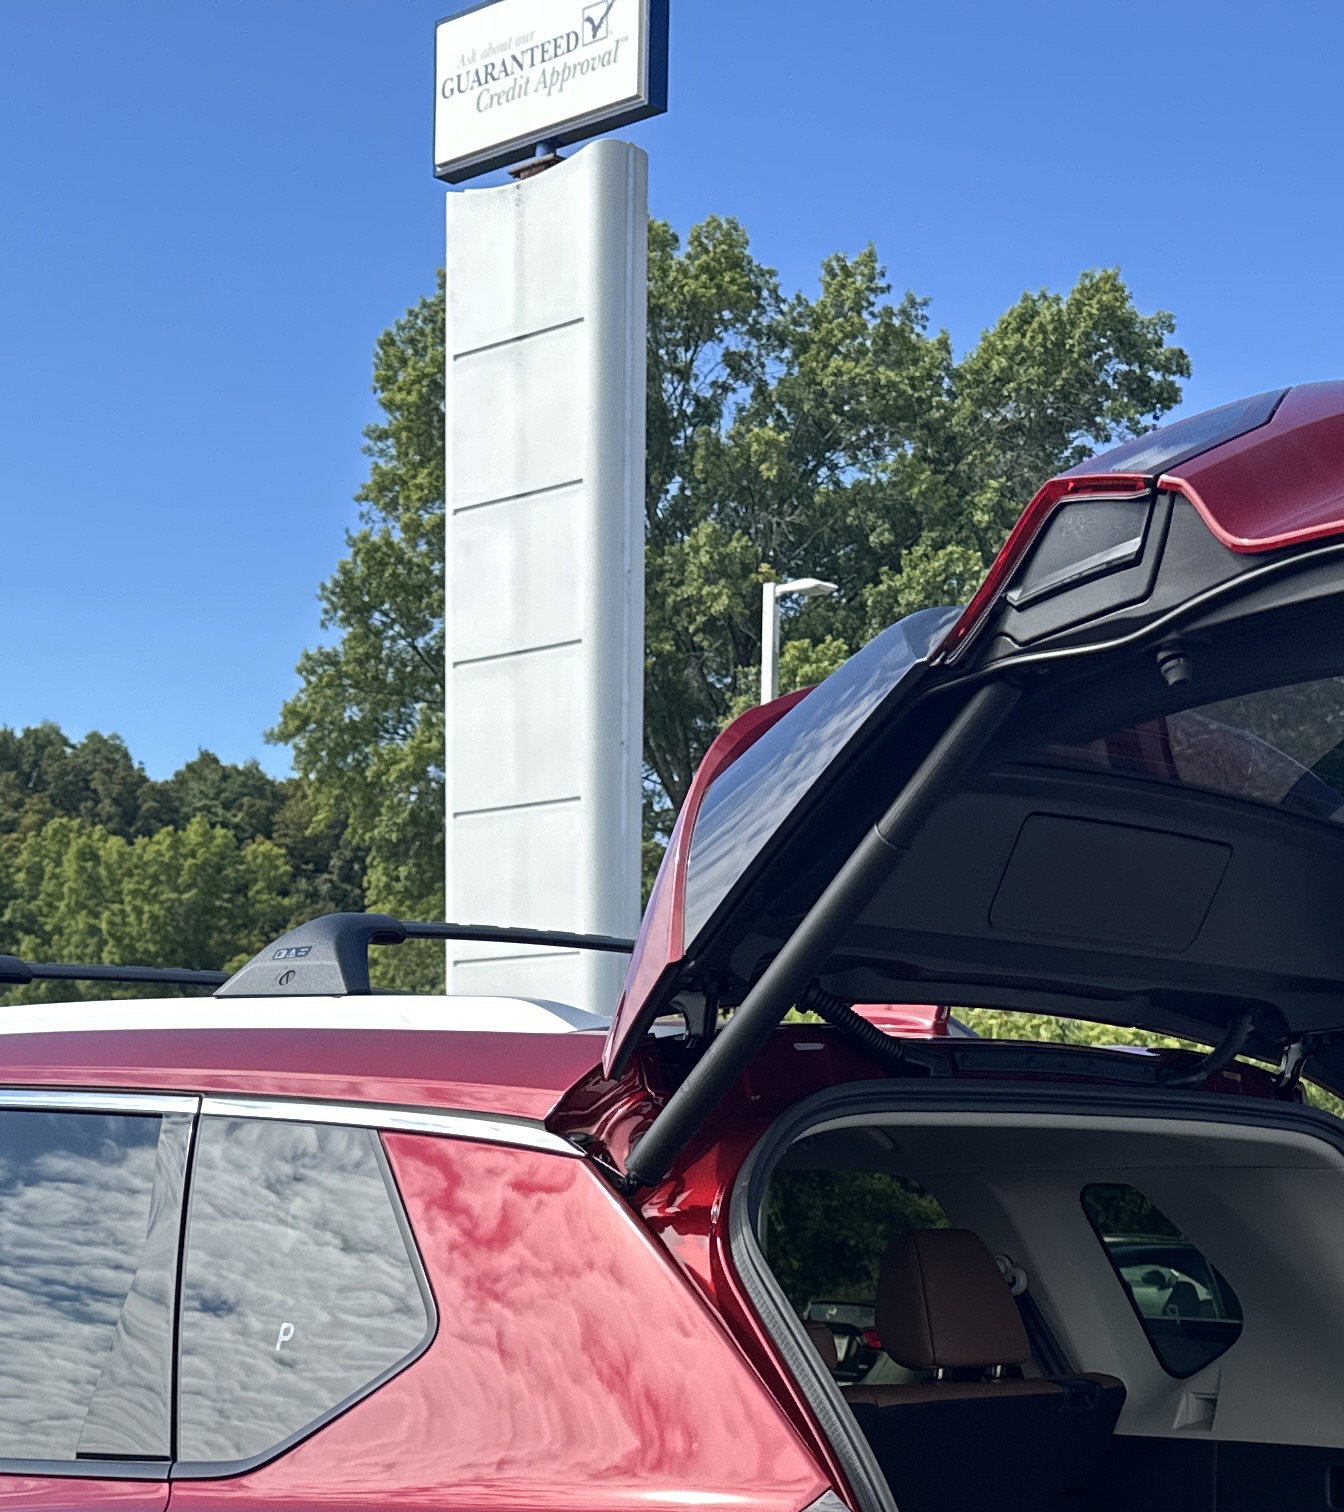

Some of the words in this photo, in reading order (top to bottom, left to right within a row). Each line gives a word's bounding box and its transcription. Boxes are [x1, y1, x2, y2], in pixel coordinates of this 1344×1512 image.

[441, 30, 579, 99] GUARANTEED
[456, 48, 477, 69] Ask
[480, 36, 512, 60] about
[515, 30, 536, 47] our
[476, 75, 530, 113] Credit
[534, 39, 619, 97] Approval
[275, 1322, 295, 1351] P
